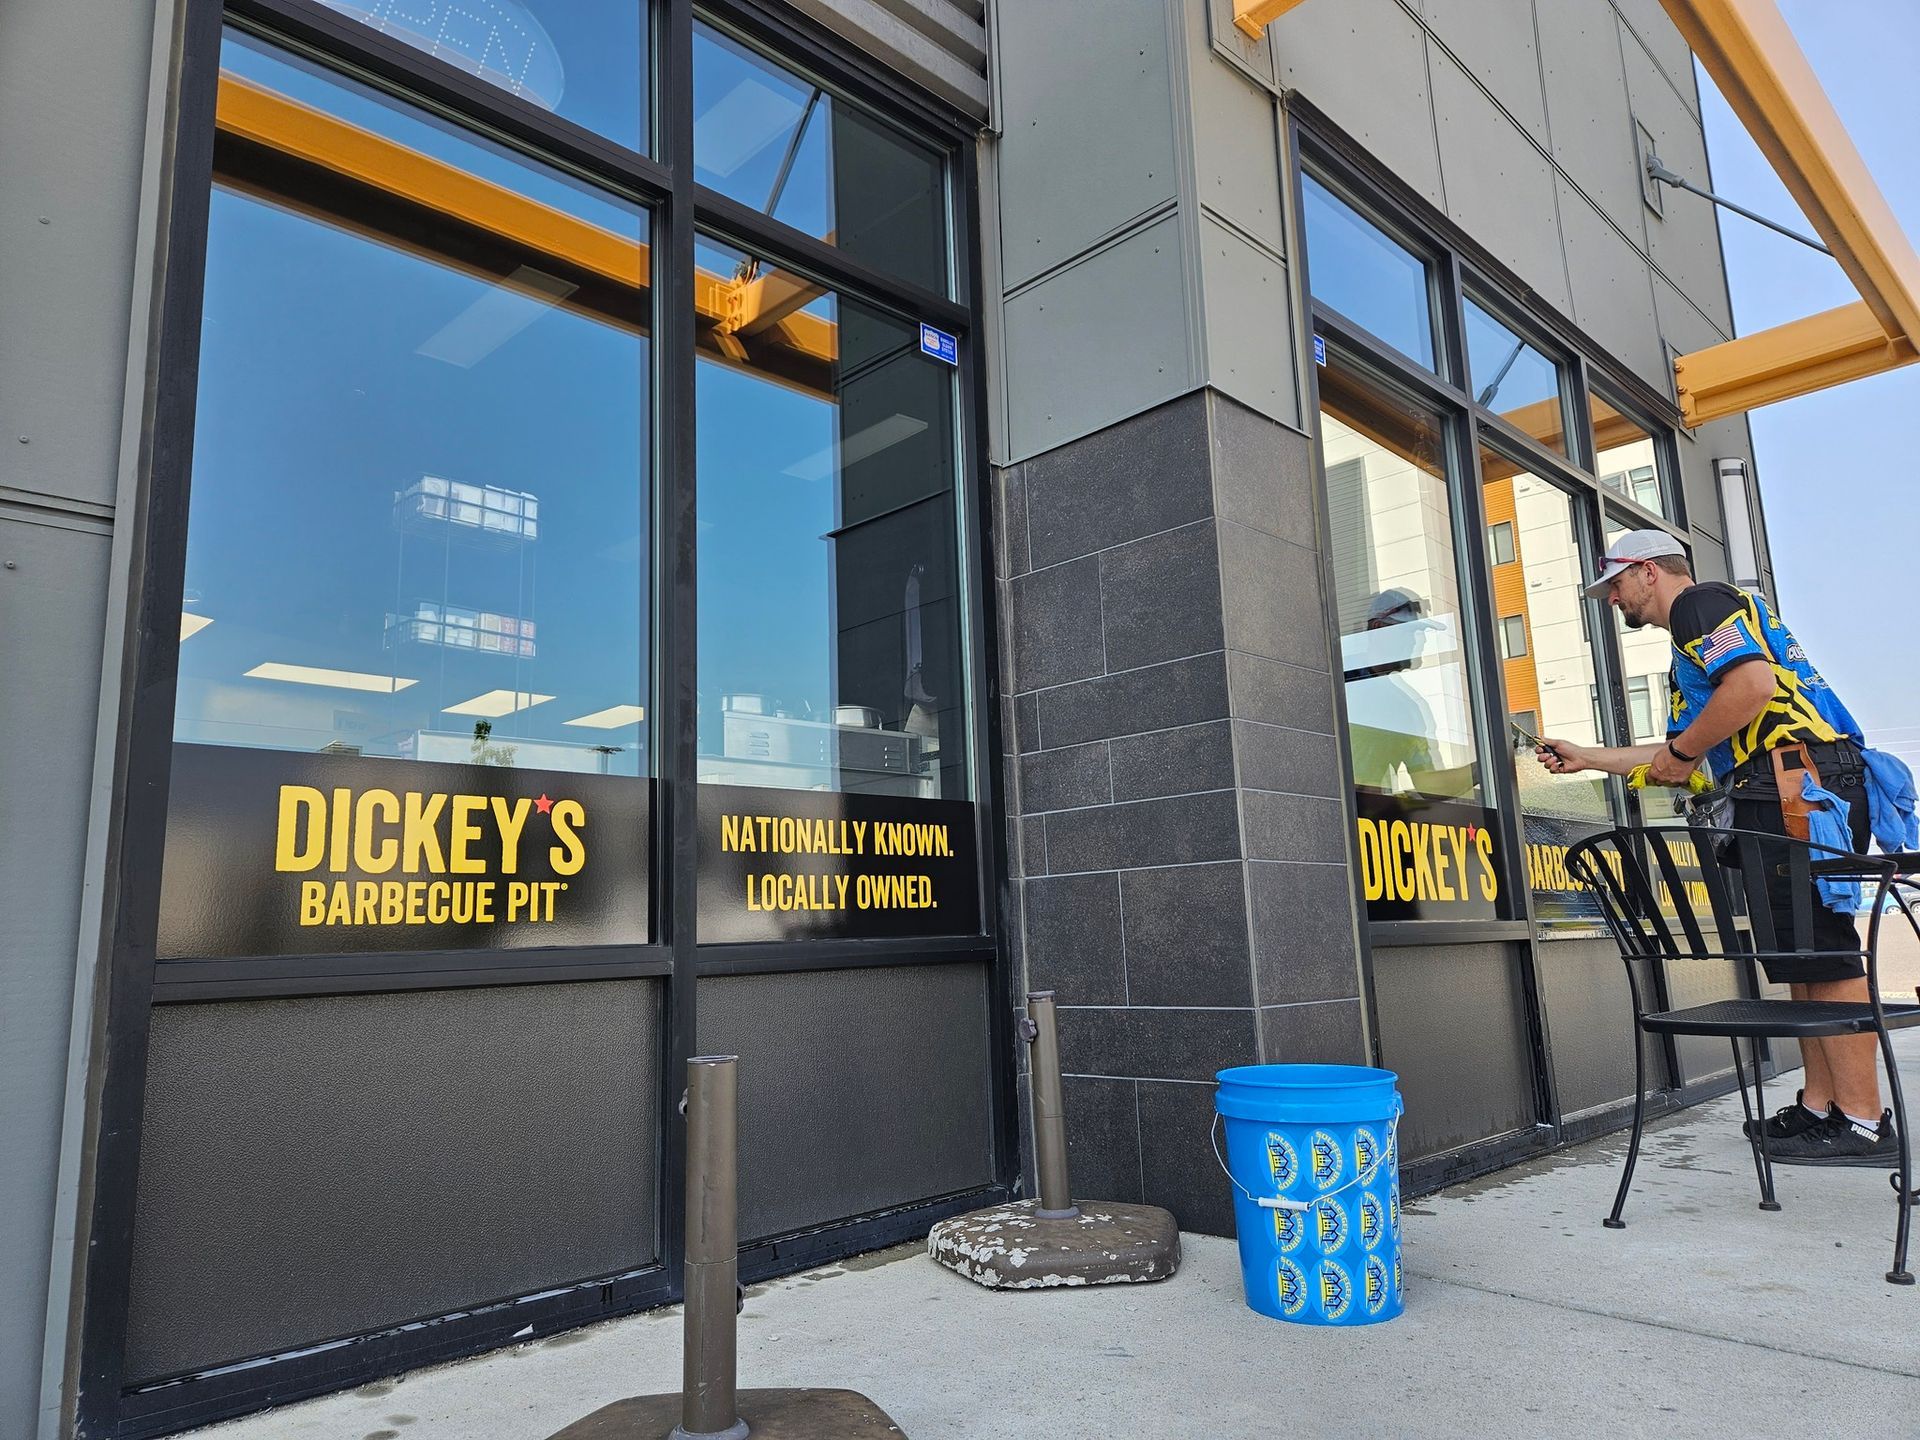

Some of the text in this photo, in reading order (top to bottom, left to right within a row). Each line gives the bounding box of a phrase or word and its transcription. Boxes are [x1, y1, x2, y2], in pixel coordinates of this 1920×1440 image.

[275, 784, 585, 876] DICKEY'S
[721, 814, 954, 857] NATIONALLY KNOWN.
[1357, 817, 1497, 902] DICKEY'S
[1525, 843, 1599, 892] BARBE
[300, 881, 496, 926] BARBECUE
[747, 873, 938, 911] LOCALLY OWNED.
[1850, 1123, 1880, 1143] PUMA
